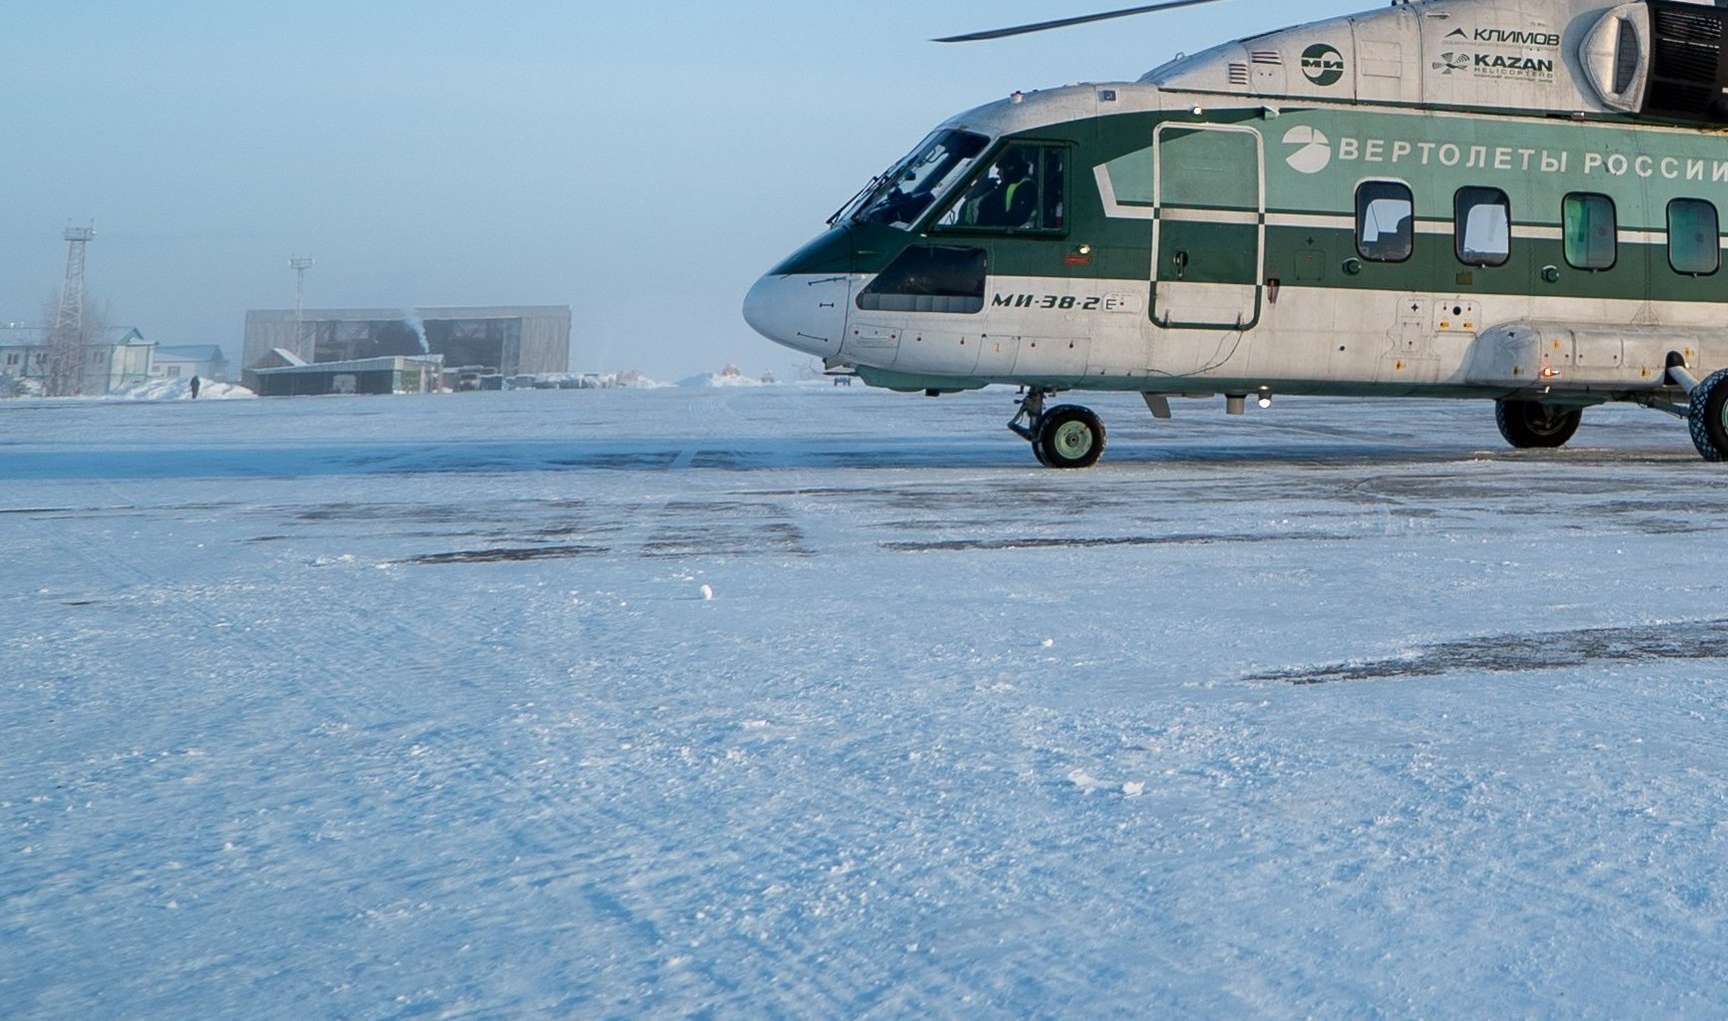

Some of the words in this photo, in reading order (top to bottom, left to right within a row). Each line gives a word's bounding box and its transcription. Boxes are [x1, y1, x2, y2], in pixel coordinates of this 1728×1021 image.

[1473, 28, 1560, 46] КЛИМОВ
[1474, 53, 1553, 72] KAZAN
[1474, 66, 1553, 79] HELICOPTERS
[1338, 137, 1568, 173] ВЕРТОЛЕТЫ
